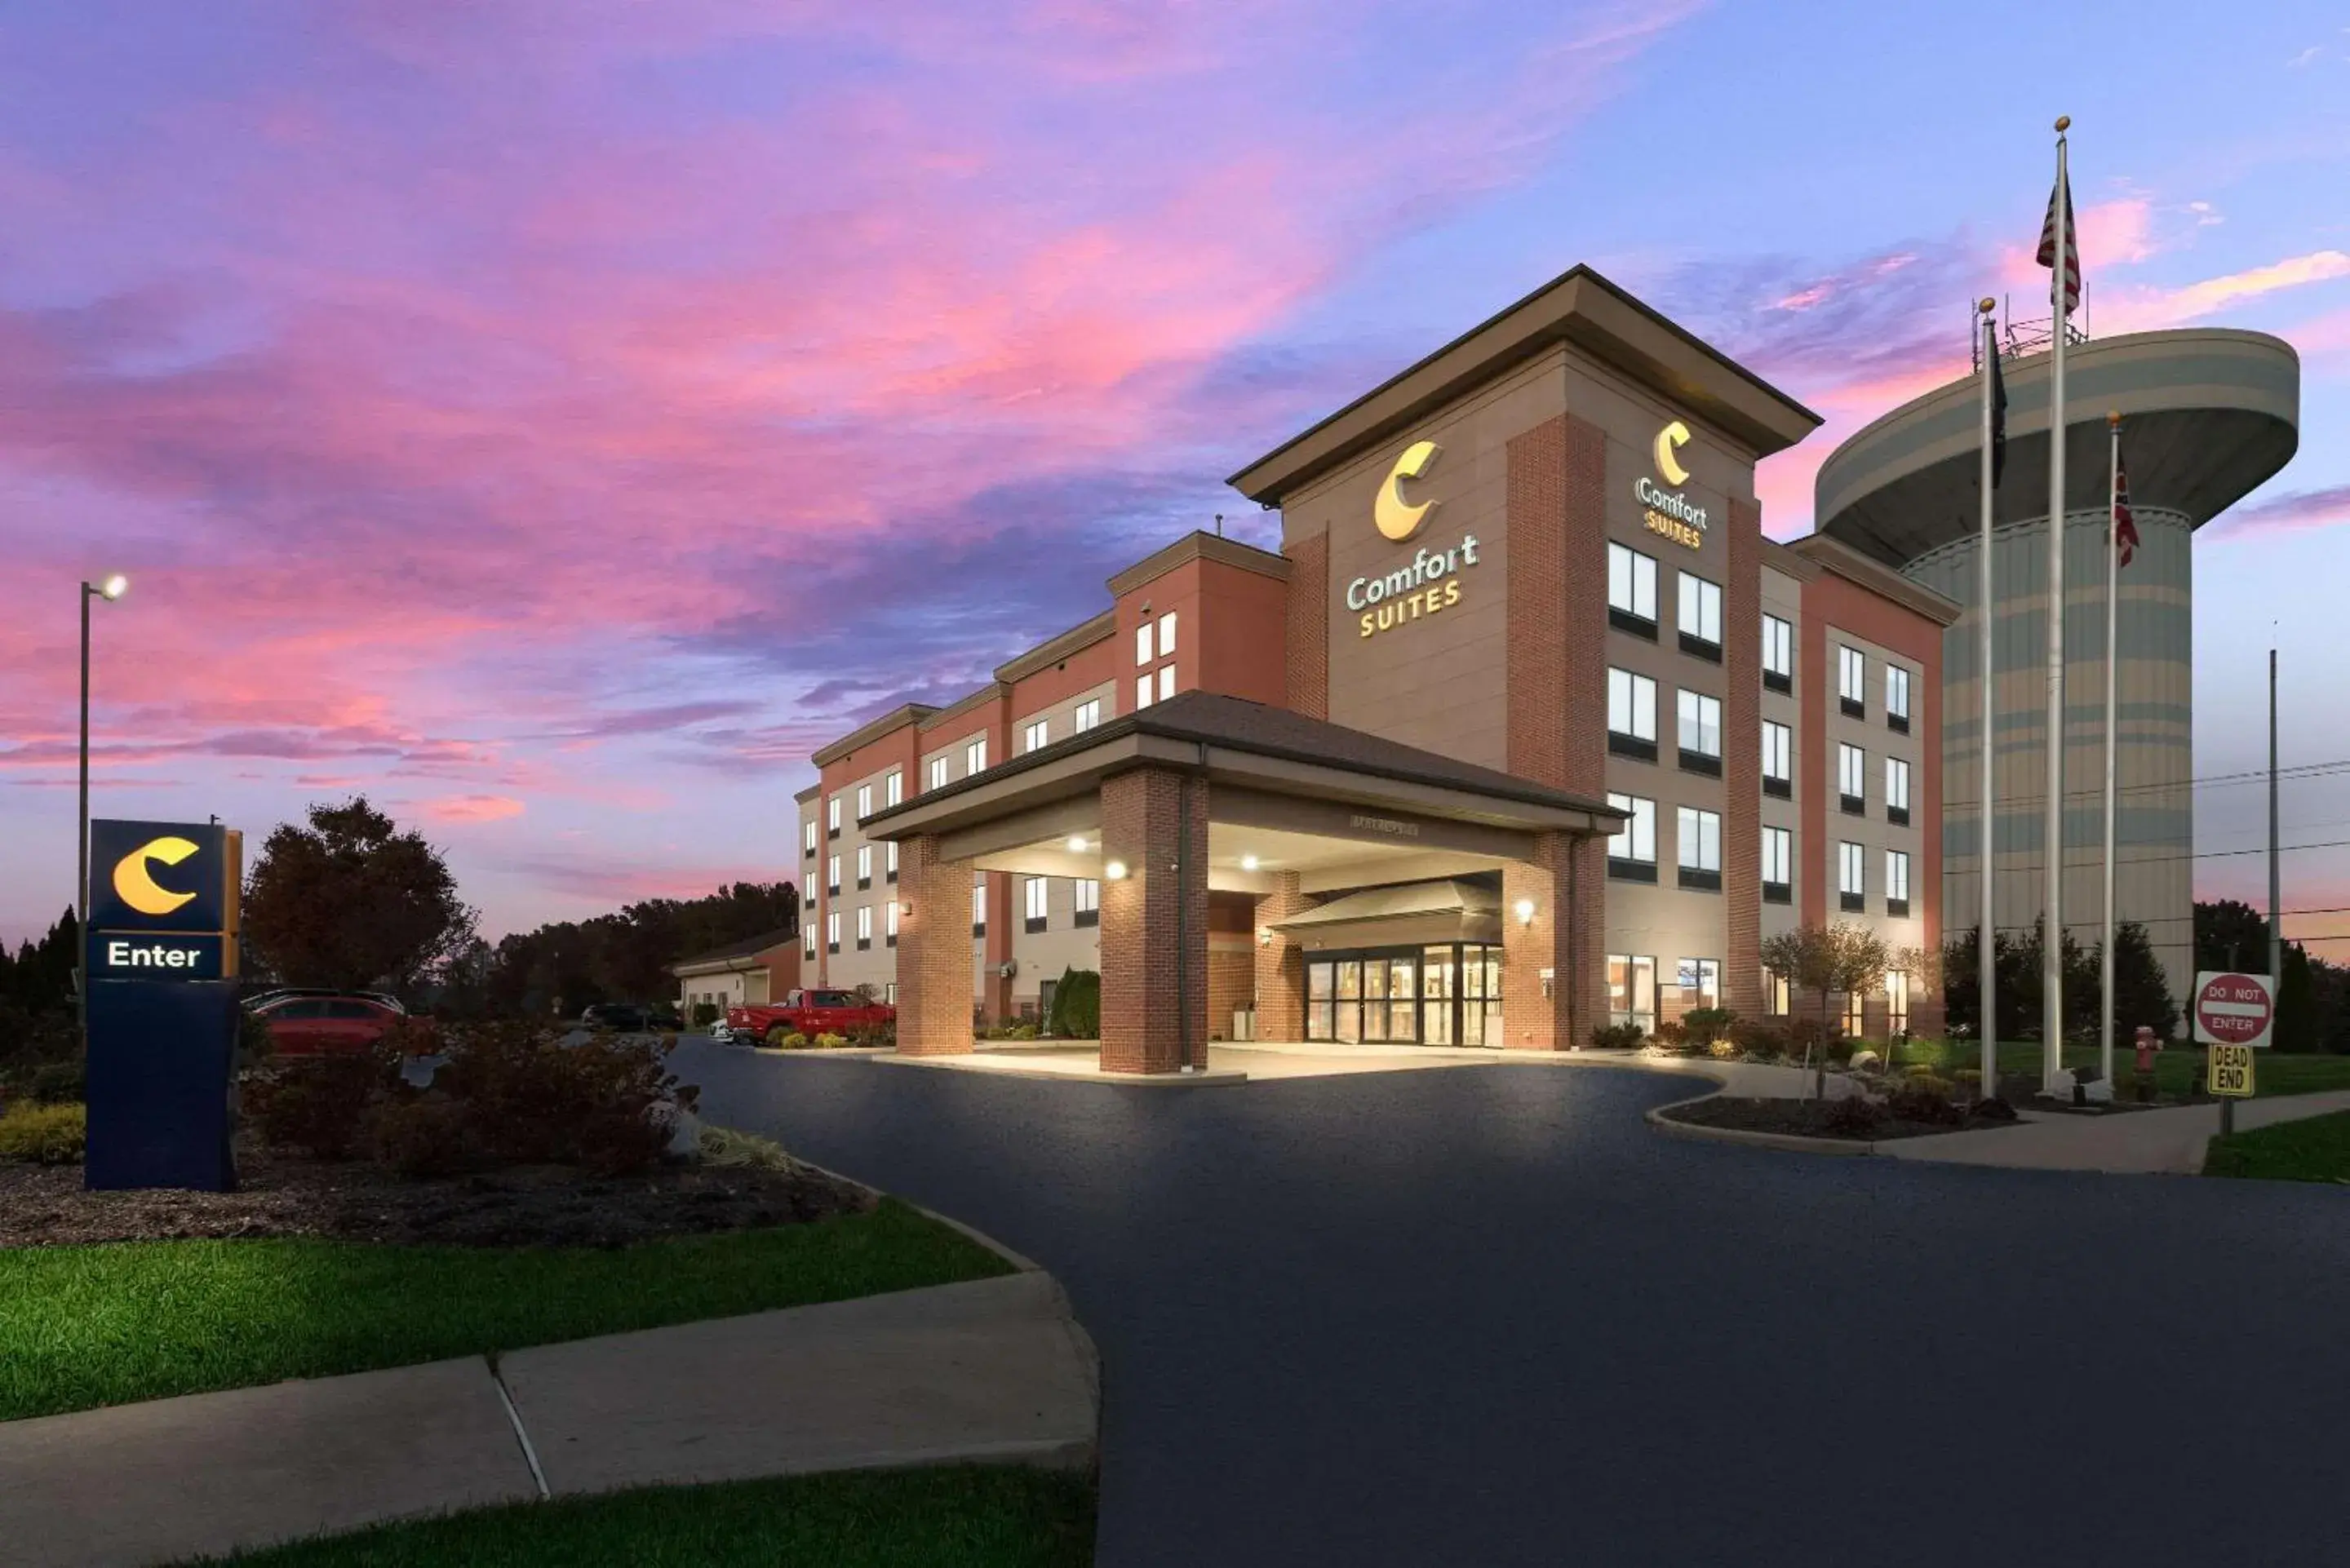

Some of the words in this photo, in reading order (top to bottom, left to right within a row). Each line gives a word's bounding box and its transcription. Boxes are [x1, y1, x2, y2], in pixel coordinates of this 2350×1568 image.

[1636, 477, 1707, 529] Comfort
[1644, 510, 1701, 549] SUITES
[1347, 534, 1479, 610] Comfort
[1360, 579, 1461, 637] SUITES
[109, 941, 201, 968] Enter
[2209, 986, 2227, 999] DO
[2236, 988, 2262, 1001] NOT
[2212, 1017, 2254, 1030] ENTER
[2215, 1046, 2247, 1067] DEAD
[2219, 1068, 2244, 1089] END
